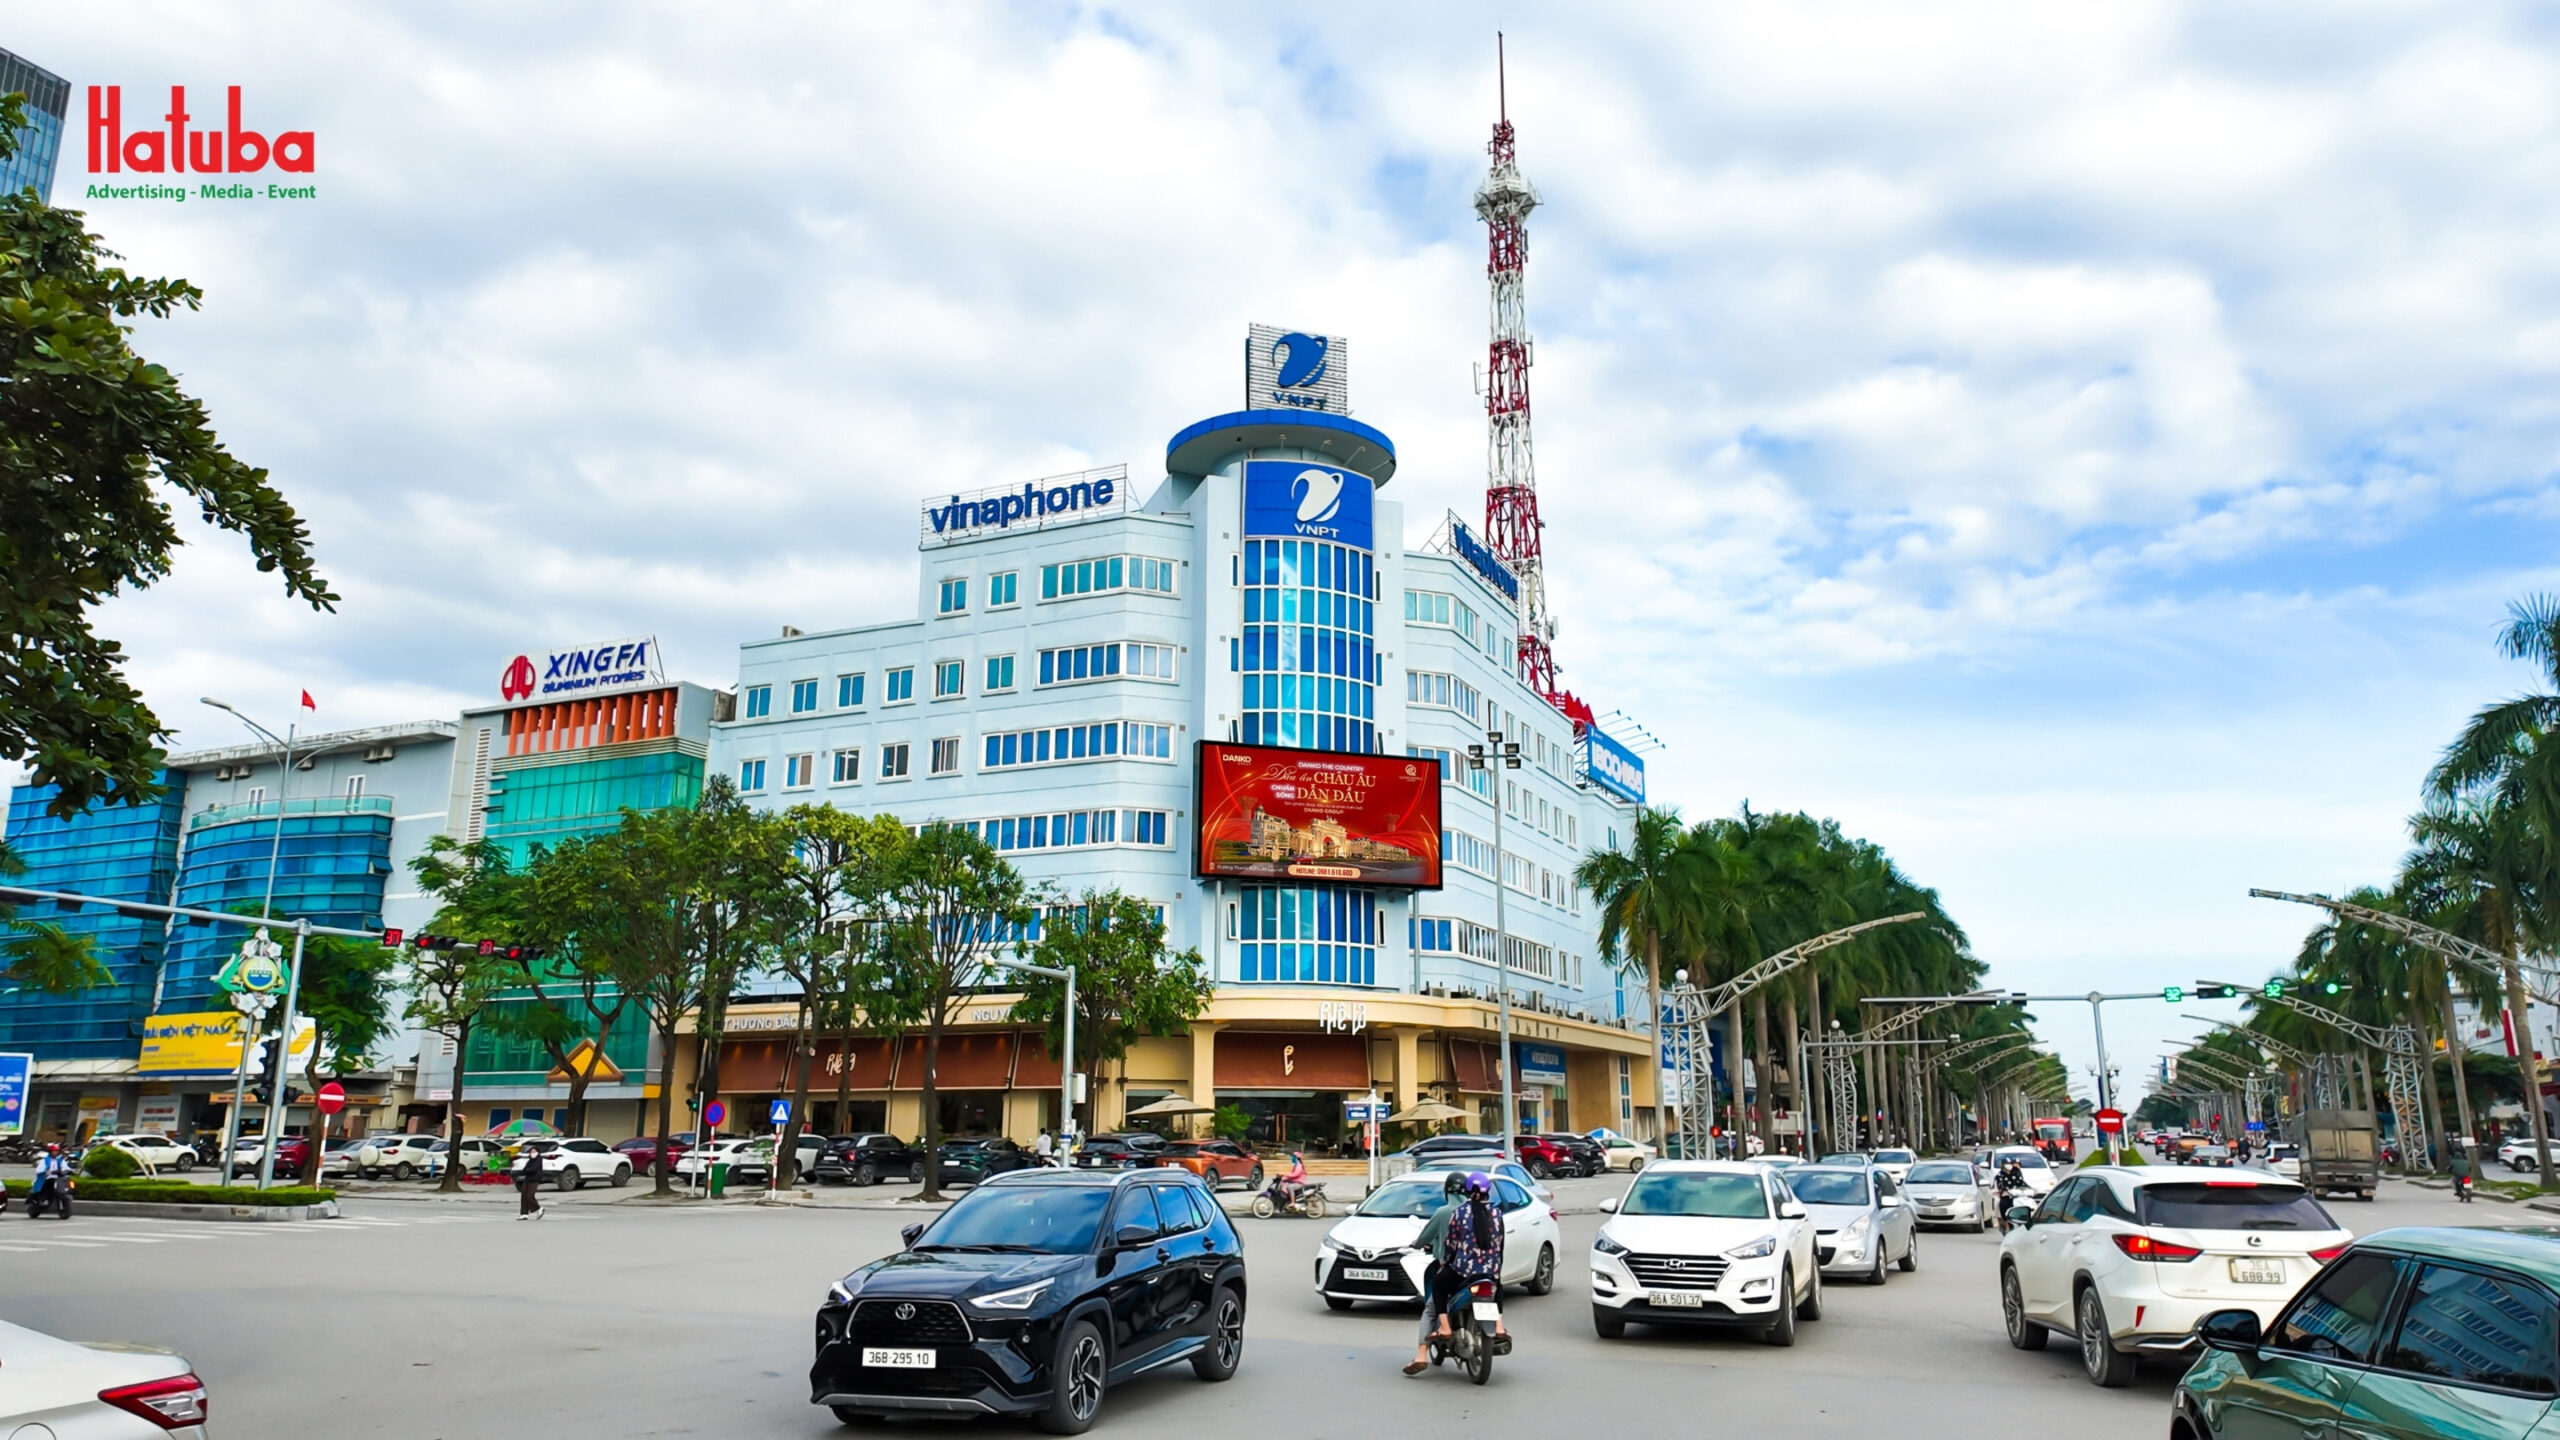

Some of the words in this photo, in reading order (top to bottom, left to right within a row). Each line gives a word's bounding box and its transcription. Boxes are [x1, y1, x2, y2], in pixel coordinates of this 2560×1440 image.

[1272, 391, 1327, 410] VNPT
[930, 478, 1114, 534] vinaphone
[1294, 523, 1340, 538] VNPT
[544, 642, 646, 680] XINGFA
[1223, 754, 1252, 763] DANKO
[1335, 764, 1365, 772] COUNTRY
[1313, 771, 1354, 786] CHÂU
[1356, 772, 1376, 787] ÂU
[385, 930, 400, 945] 37
[480, 941, 493, 955] 37
[2165, 988, 2181, 1001] 32
[2267, 984, 2281, 997] 32
